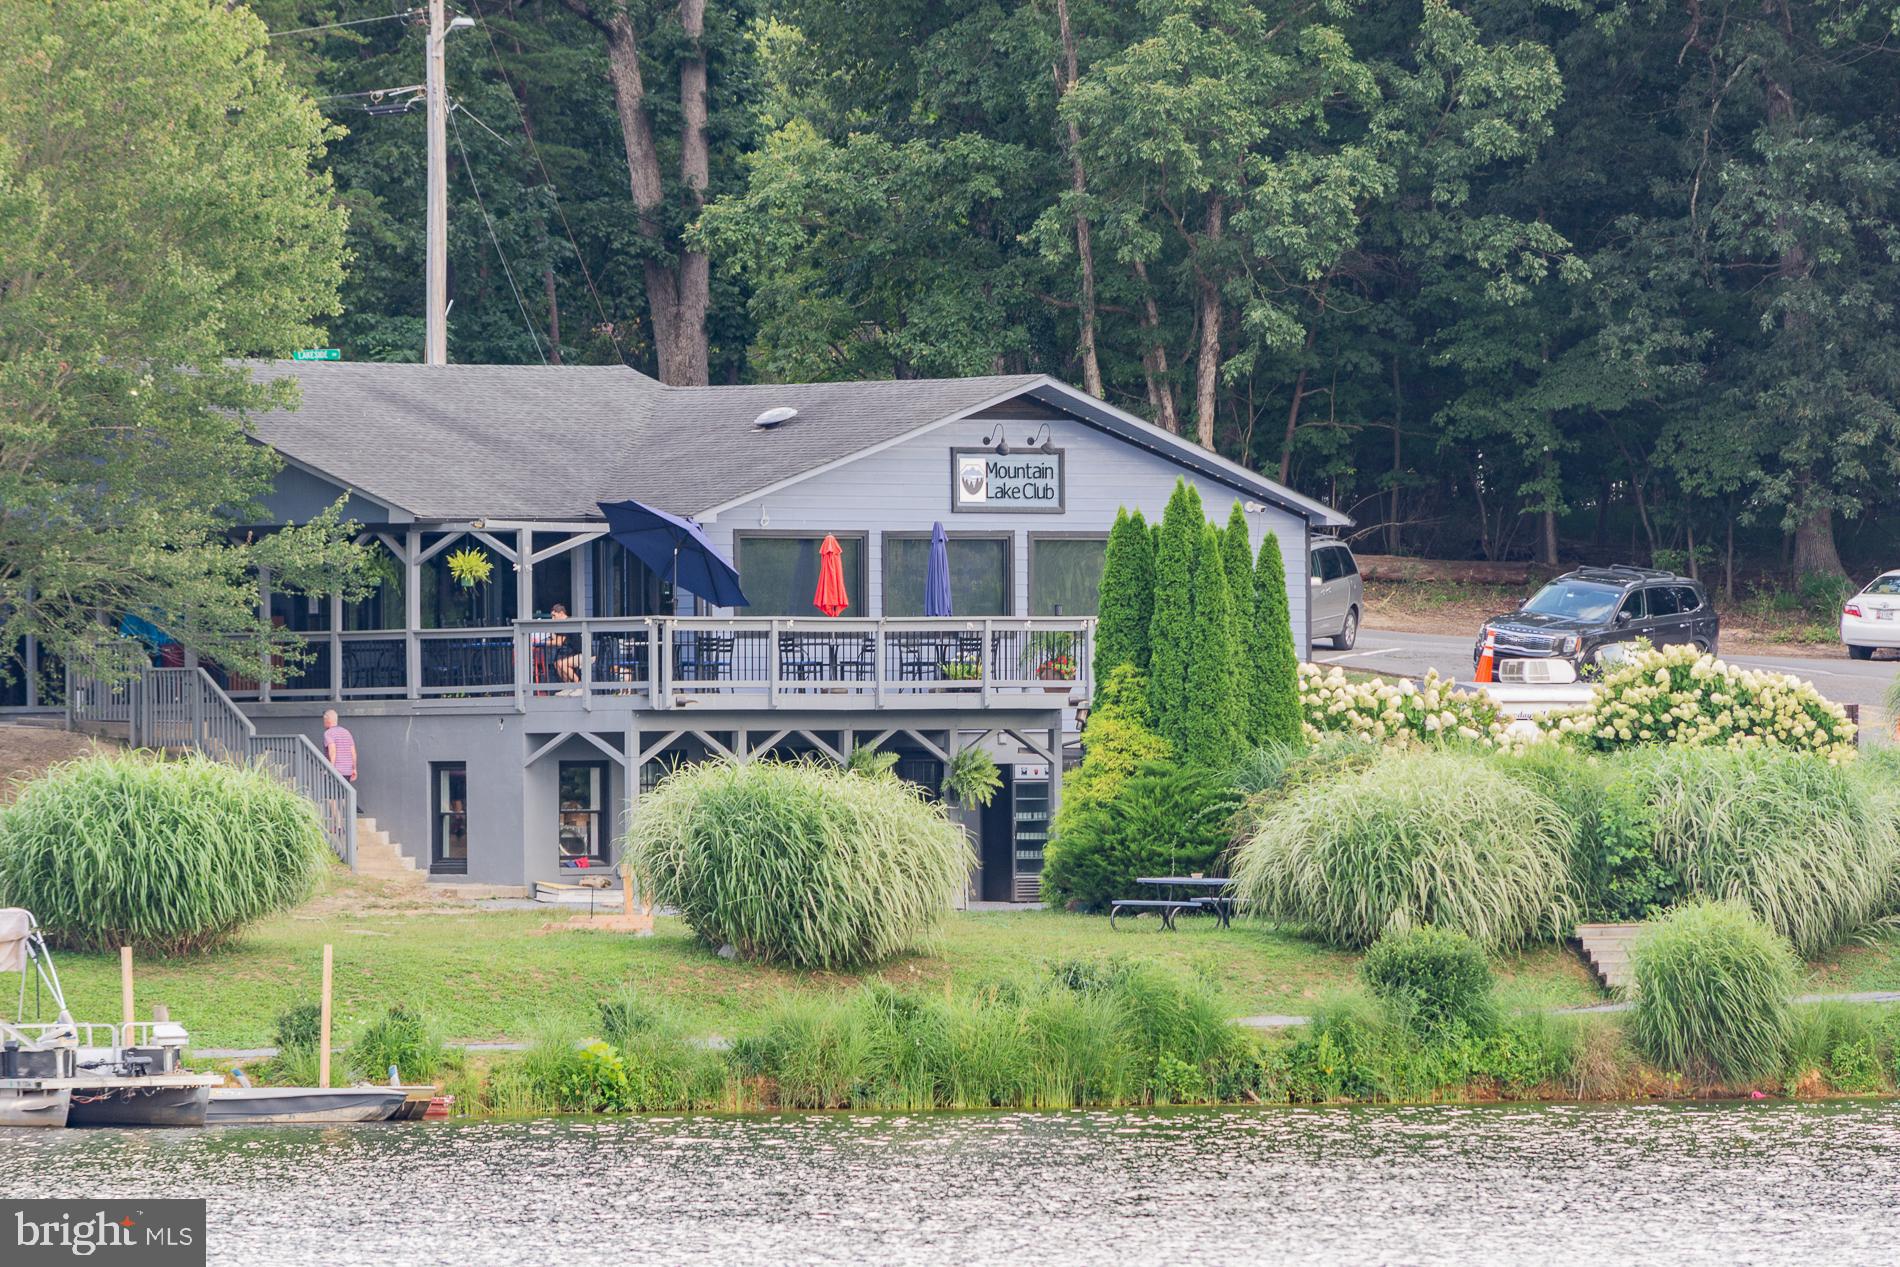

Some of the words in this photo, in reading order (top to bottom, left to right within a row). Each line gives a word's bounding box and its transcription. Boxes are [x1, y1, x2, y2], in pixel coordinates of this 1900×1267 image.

[986, 462, 1054, 479] Mountain
[986, 482, 1021, 499] Lake
[1023, 482, 1055, 500] Club
